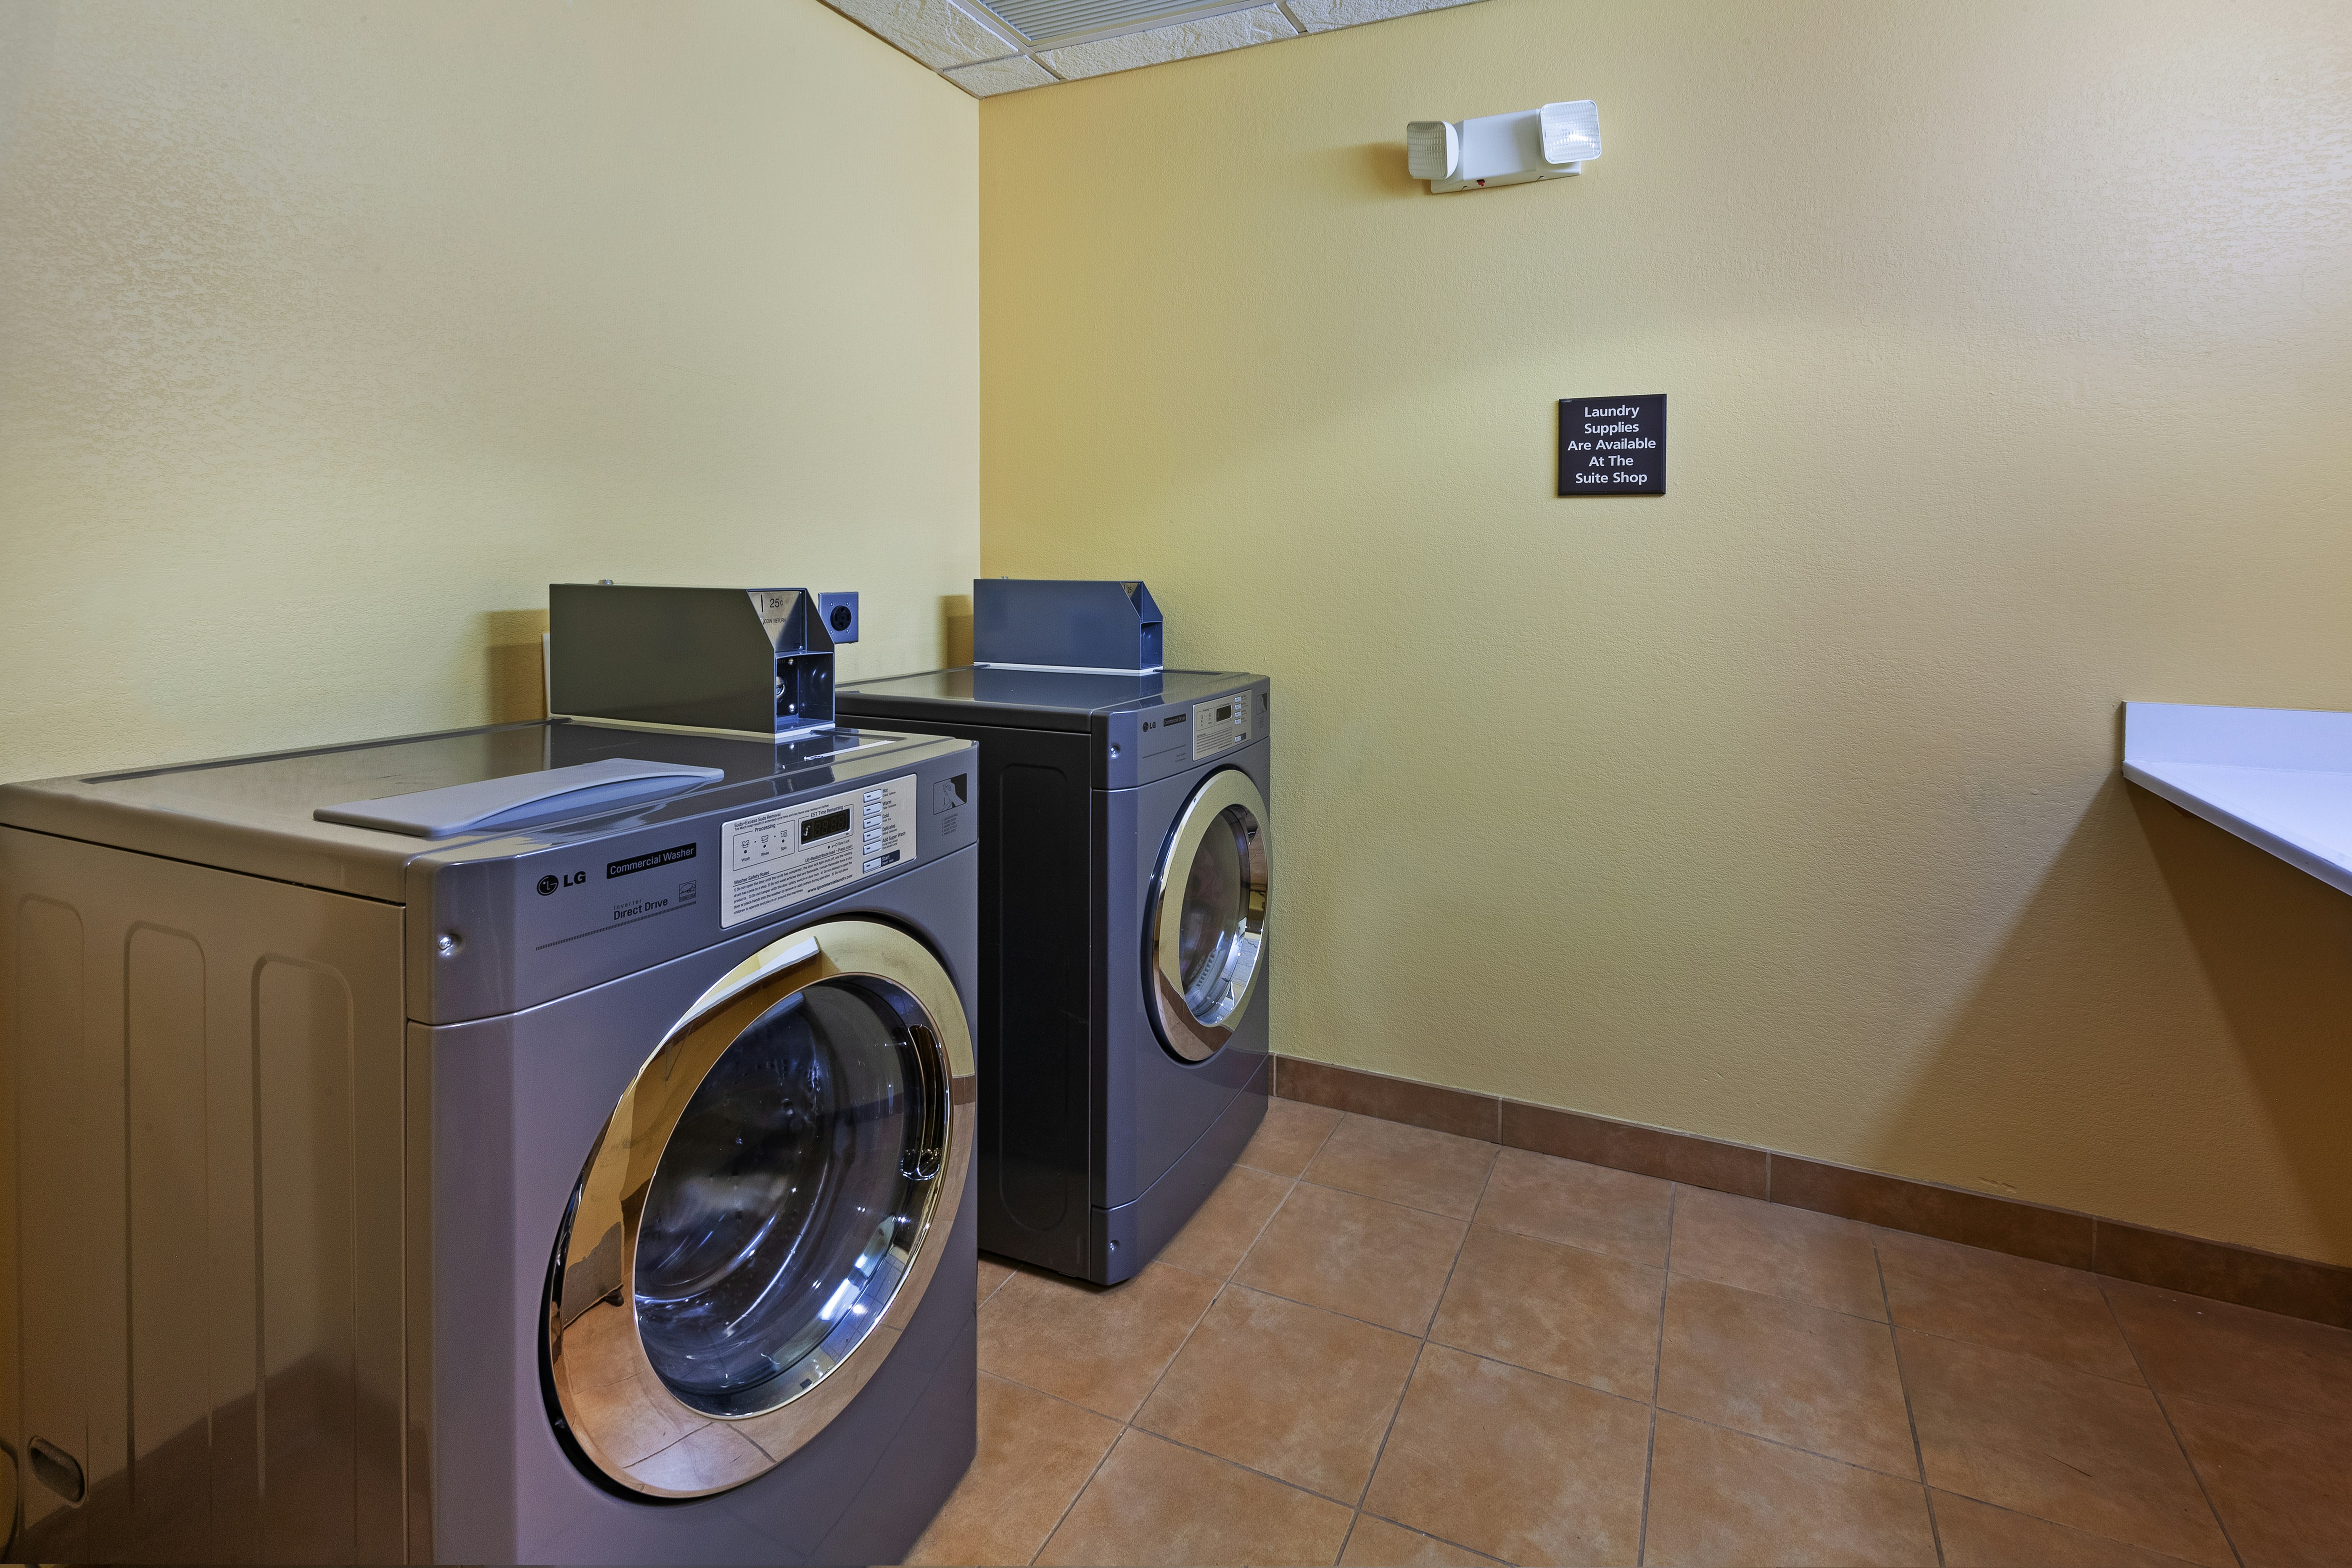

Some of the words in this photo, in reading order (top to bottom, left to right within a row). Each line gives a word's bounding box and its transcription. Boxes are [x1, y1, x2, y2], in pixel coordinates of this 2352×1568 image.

[1585, 404, 1639, 418] Laundry
[1584, 422, 1639, 436] Supplies
[1568, 440, 1592, 451] Are
[1595, 437, 1656, 450] Available
[1589, 456, 1605, 467] At
[1608, 455, 1634, 466] The
[1576, 472, 1608, 483] Suite
[1613, 472, 1647, 485] Shop
[755, 824, 776, 832] Processing
[610, 855, 661, 874] Commercial
[663, 848, 694, 861] Washer
[563, 871, 586, 888] LG
[614, 899, 642, 910] Inverter
[614, 904, 642, 920] Direct
[645, 898, 668, 911] Drive
